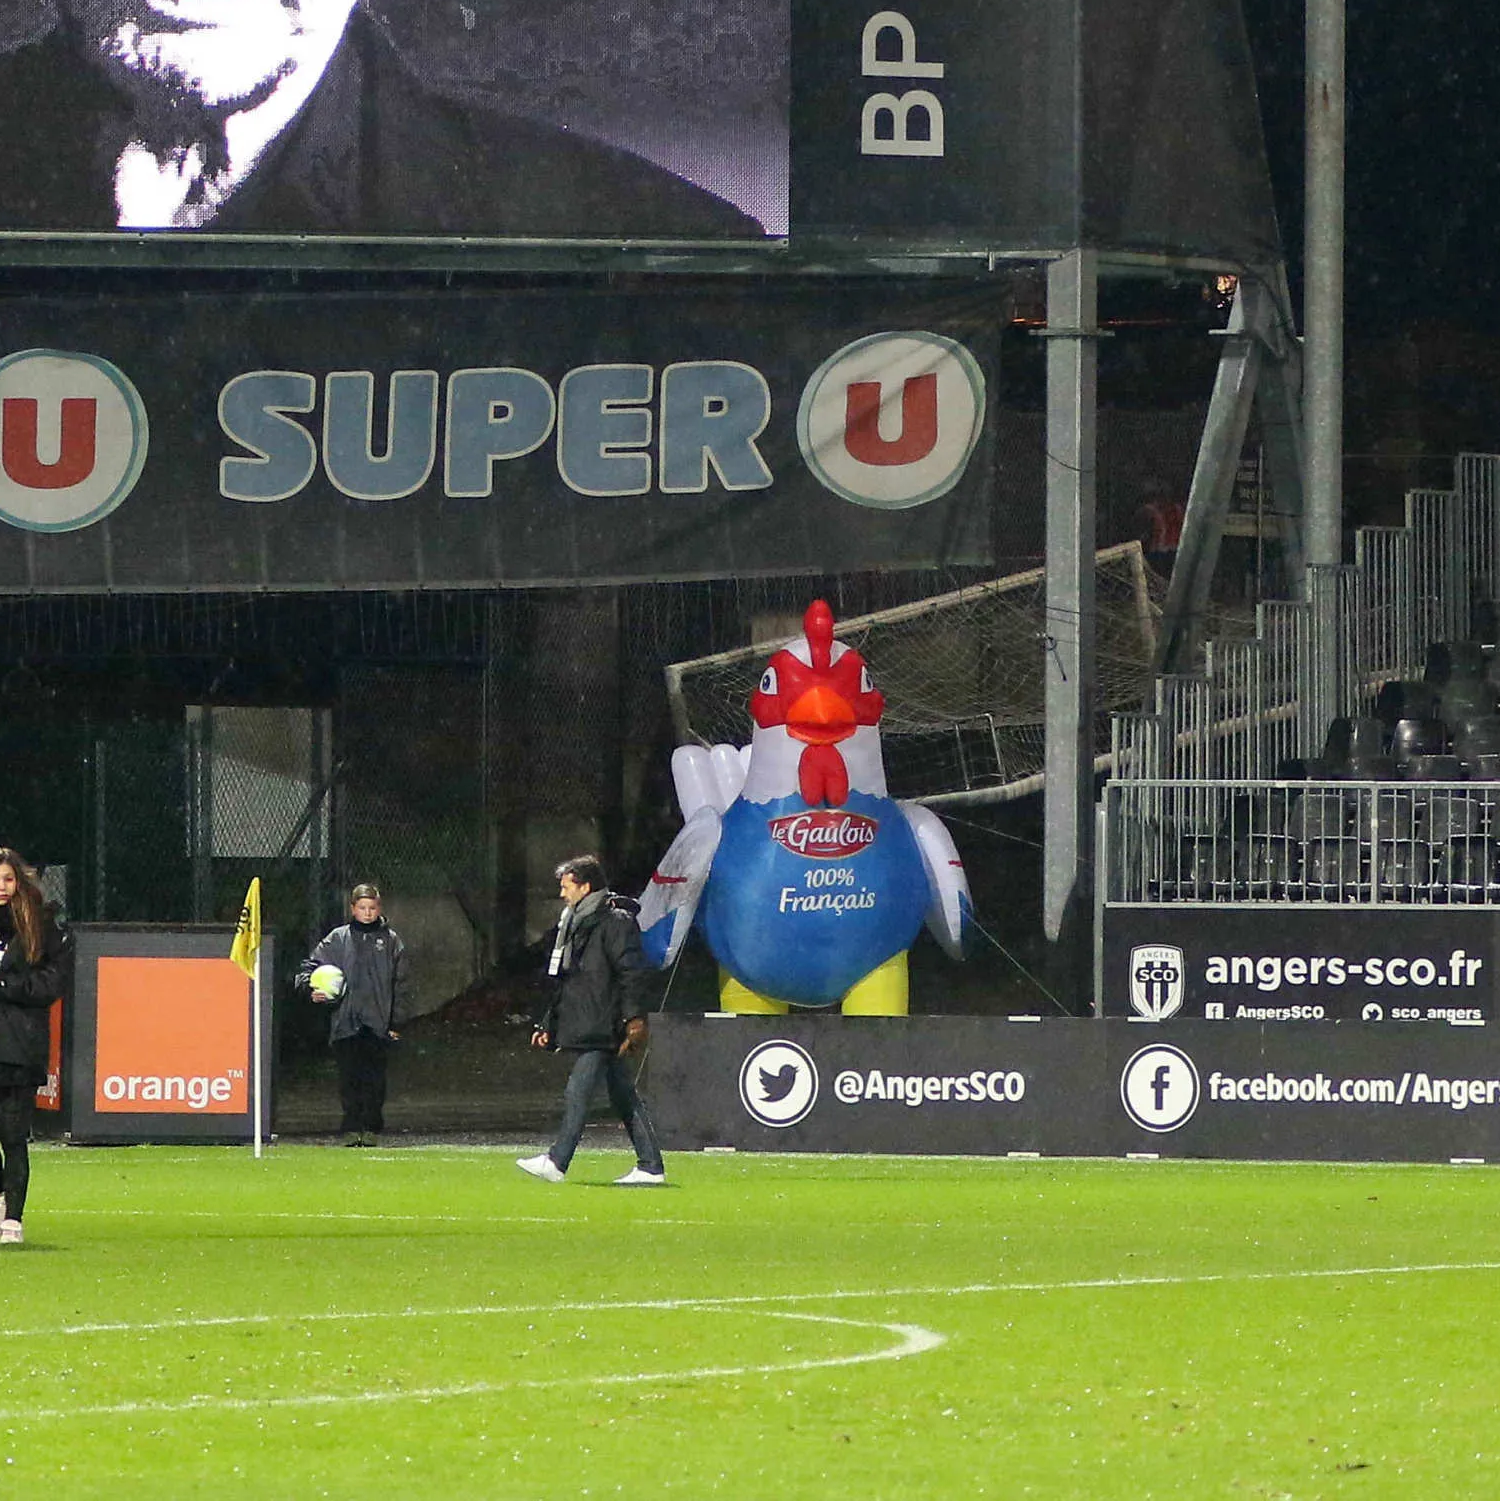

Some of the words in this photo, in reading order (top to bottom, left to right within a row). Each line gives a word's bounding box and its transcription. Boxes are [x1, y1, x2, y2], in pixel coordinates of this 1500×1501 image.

[860, 9, 945, 158] BP
[2, 397, 98, 490] U
[217, 360, 775, 503] SUPER
[844, 372, 938, 467] U
[787, 815, 875, 852] Gaulois
[804, 867, 855, 889] 100%
[779, 886, 876, 916] Français
[1141, 951, 1175, 960] ANGERS
[1204, 949, 1483, 991] angers-sco.fr
[1138, 969, 1175, 982] SCO
[1235, 1004, 1325, 1020] AngersSCO
[102, 1074, 232, 1109] orange
[833, 1069, 1026, 1106] @AngersSCO
